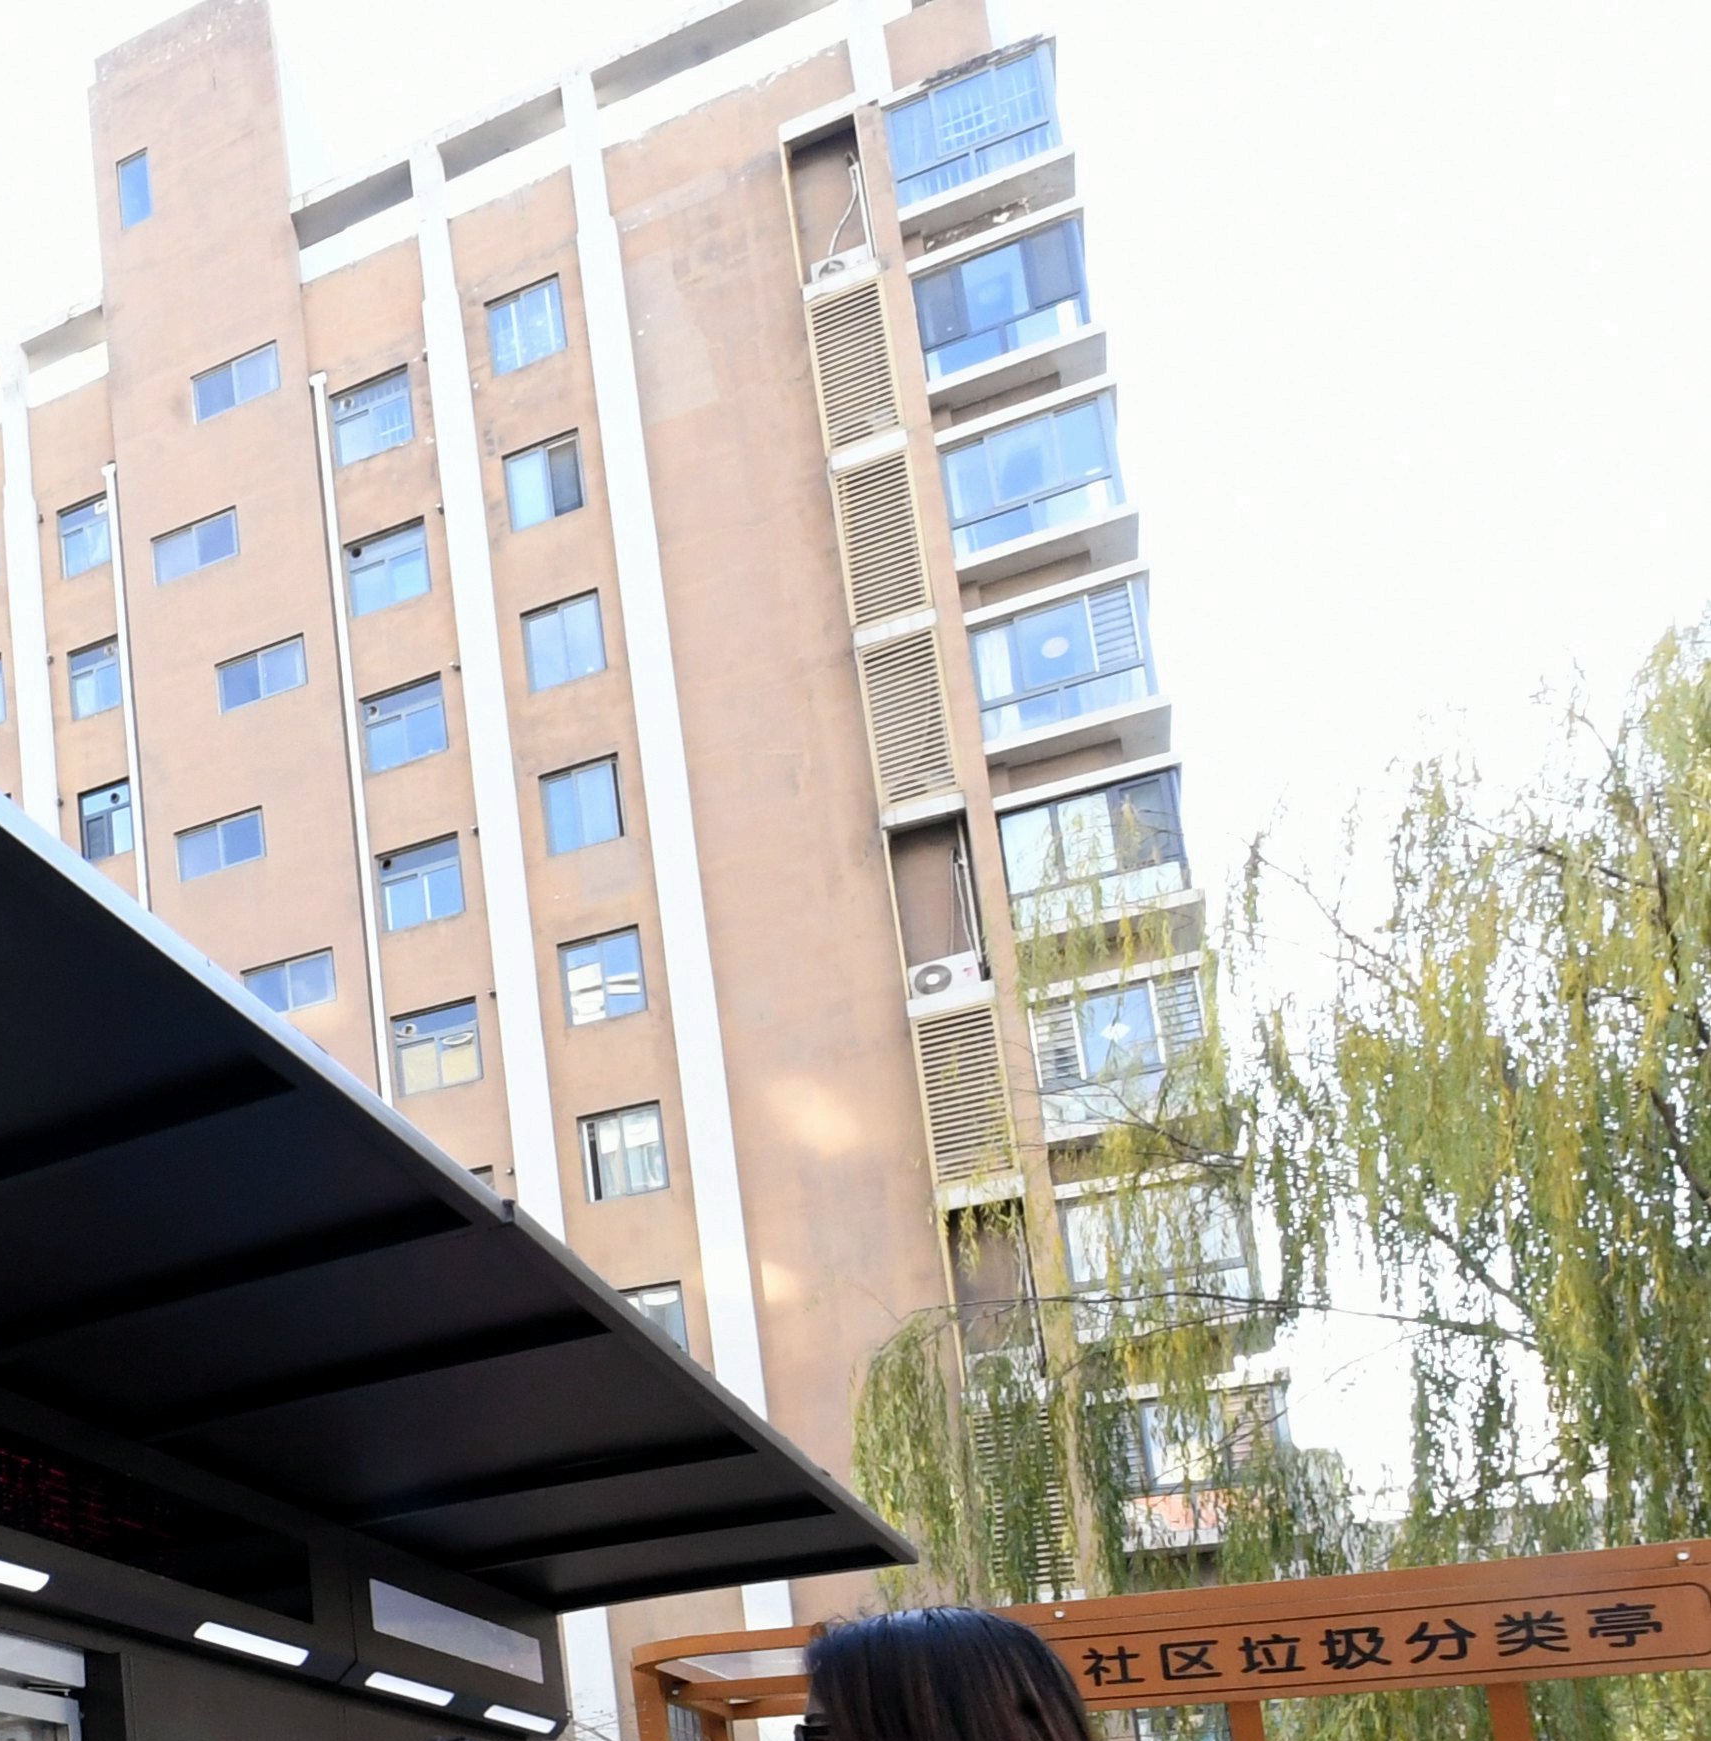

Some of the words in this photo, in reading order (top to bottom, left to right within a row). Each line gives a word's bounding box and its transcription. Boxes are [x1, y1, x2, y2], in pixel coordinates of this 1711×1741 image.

[1082, 1601, 1665, 1688] 社区垃圾分类亭
